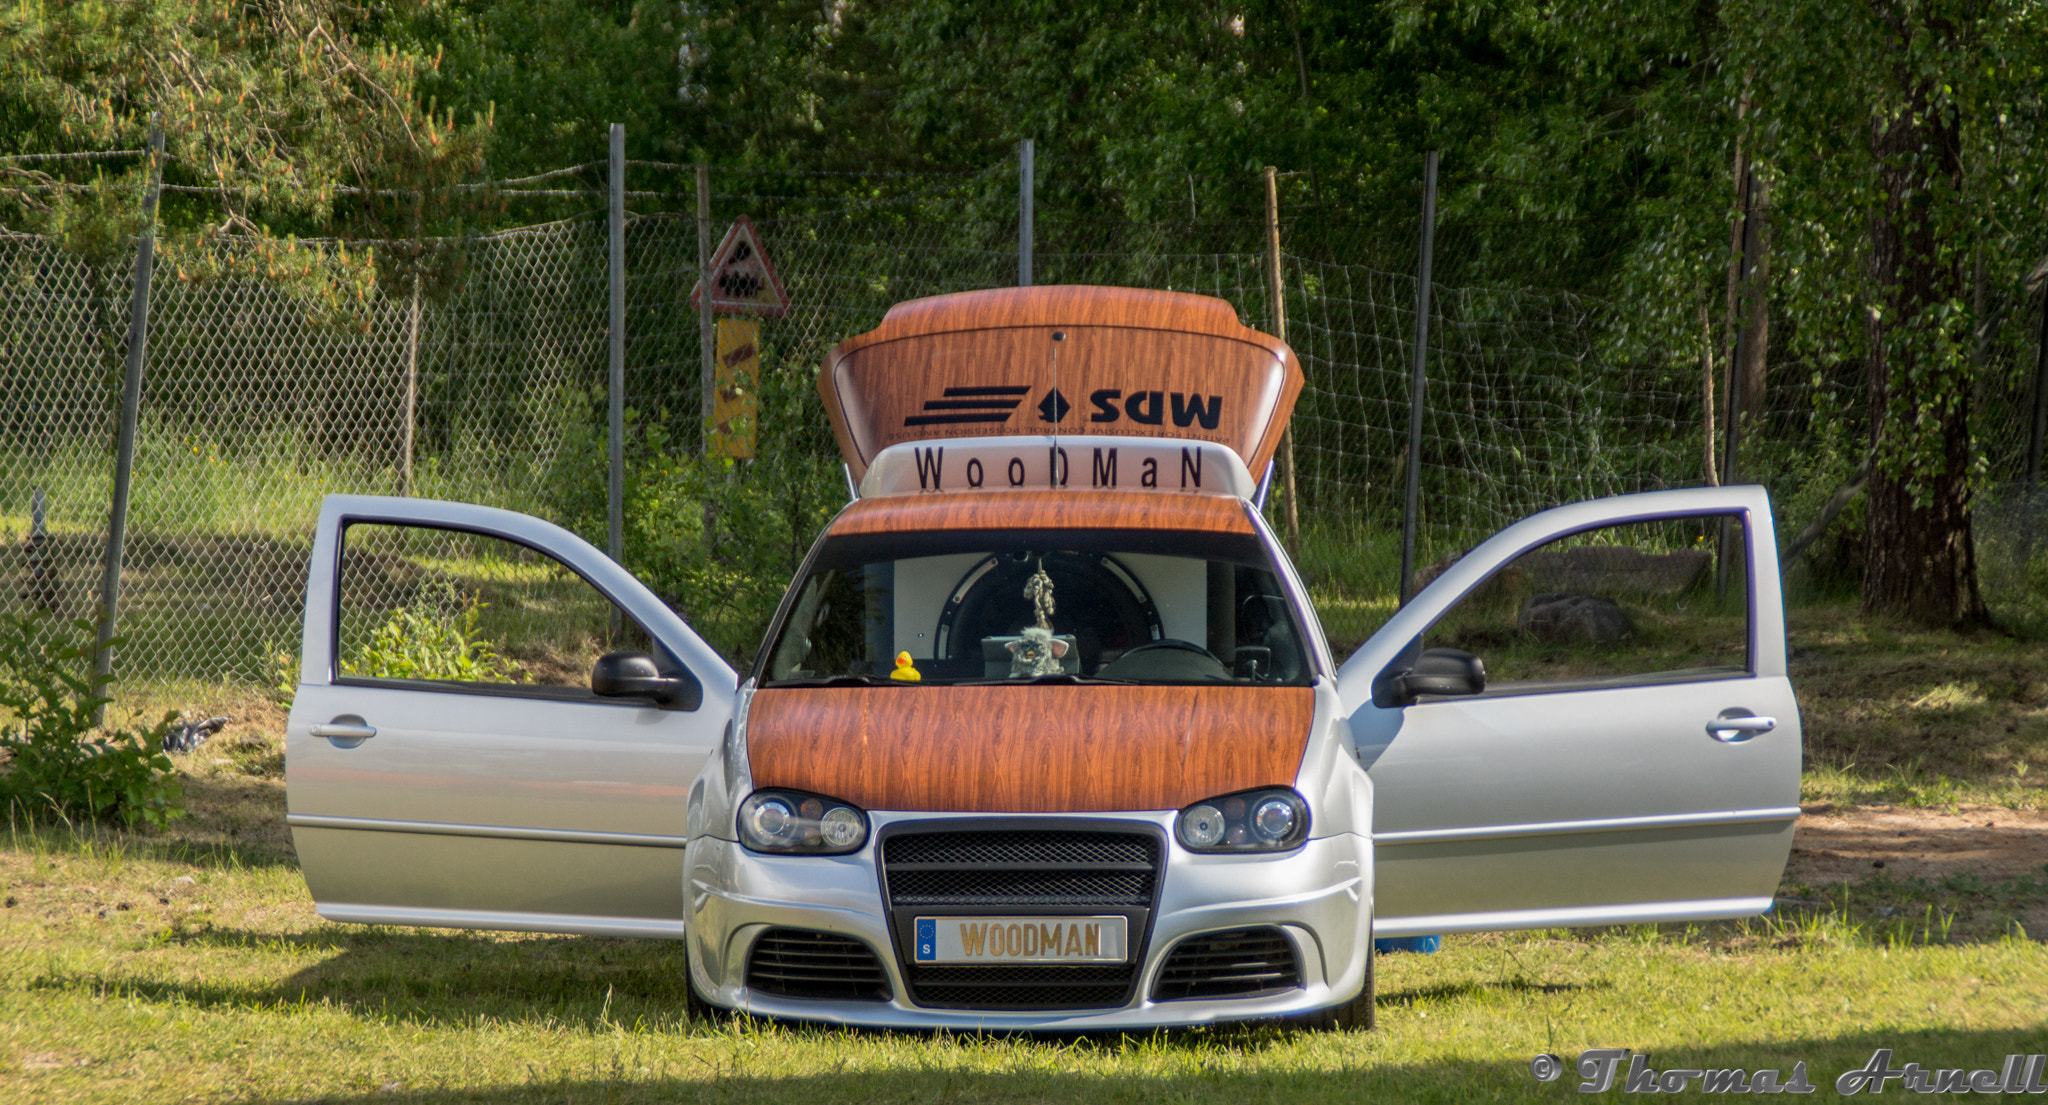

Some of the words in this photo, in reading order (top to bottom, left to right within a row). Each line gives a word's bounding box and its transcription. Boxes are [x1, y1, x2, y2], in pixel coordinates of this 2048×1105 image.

[1090, 388, 1224, 430] MDS
[888, 431, 911, 440] USE
[914, 429, 940, 437] AND
[945, 426, 1020, 436] POSSESSION
[1090, 427, 1154, 437] EXCLUSIVE
[1157, 429, 1182, 438] FOR
[1185, 430, 1231, 444] PATENT
[959, 922, 1100, 957] WOODMAN
[922, 944, 931, 955] S
